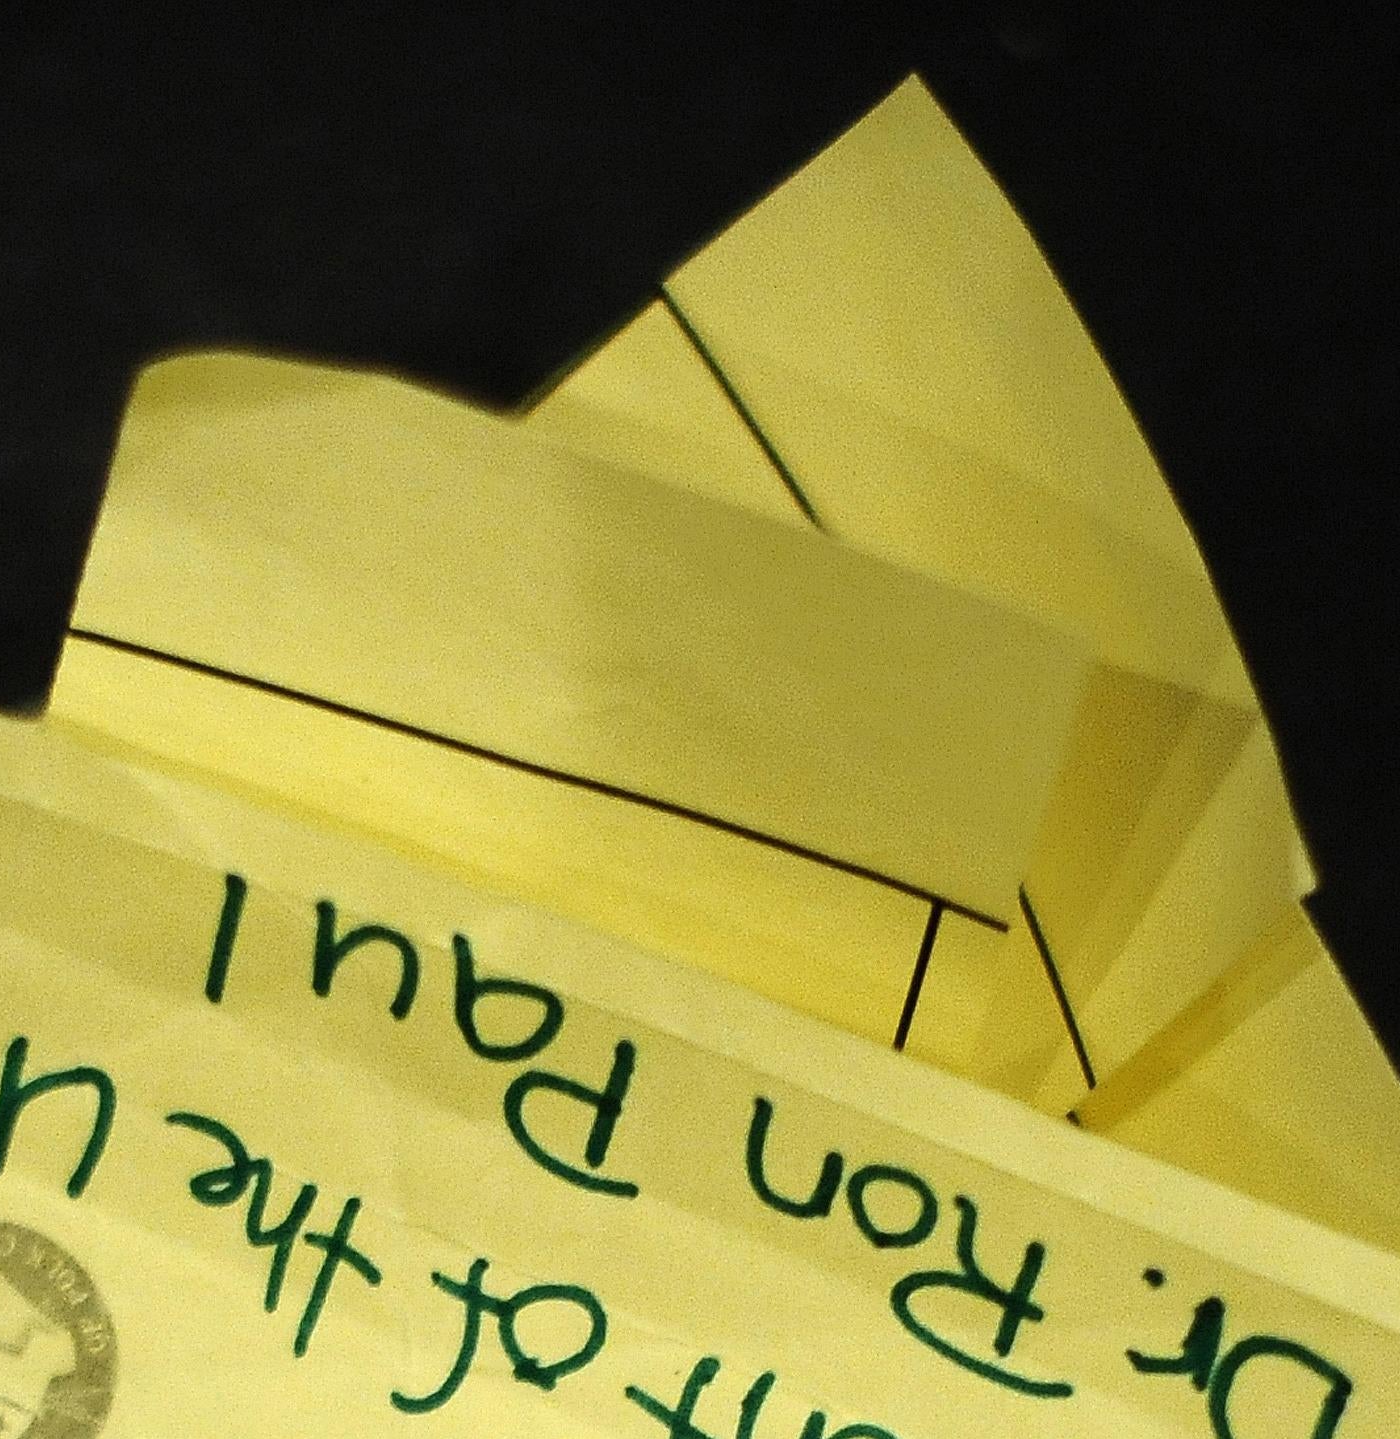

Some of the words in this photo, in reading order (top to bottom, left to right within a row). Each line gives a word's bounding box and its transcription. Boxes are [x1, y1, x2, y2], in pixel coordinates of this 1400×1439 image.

[203, 880, 642, 1197] Paul
[165, 1111, 383, 1357] the
[390, 1257, 610, 1414] of
[744, 1097, 1075, 1399] Ron
